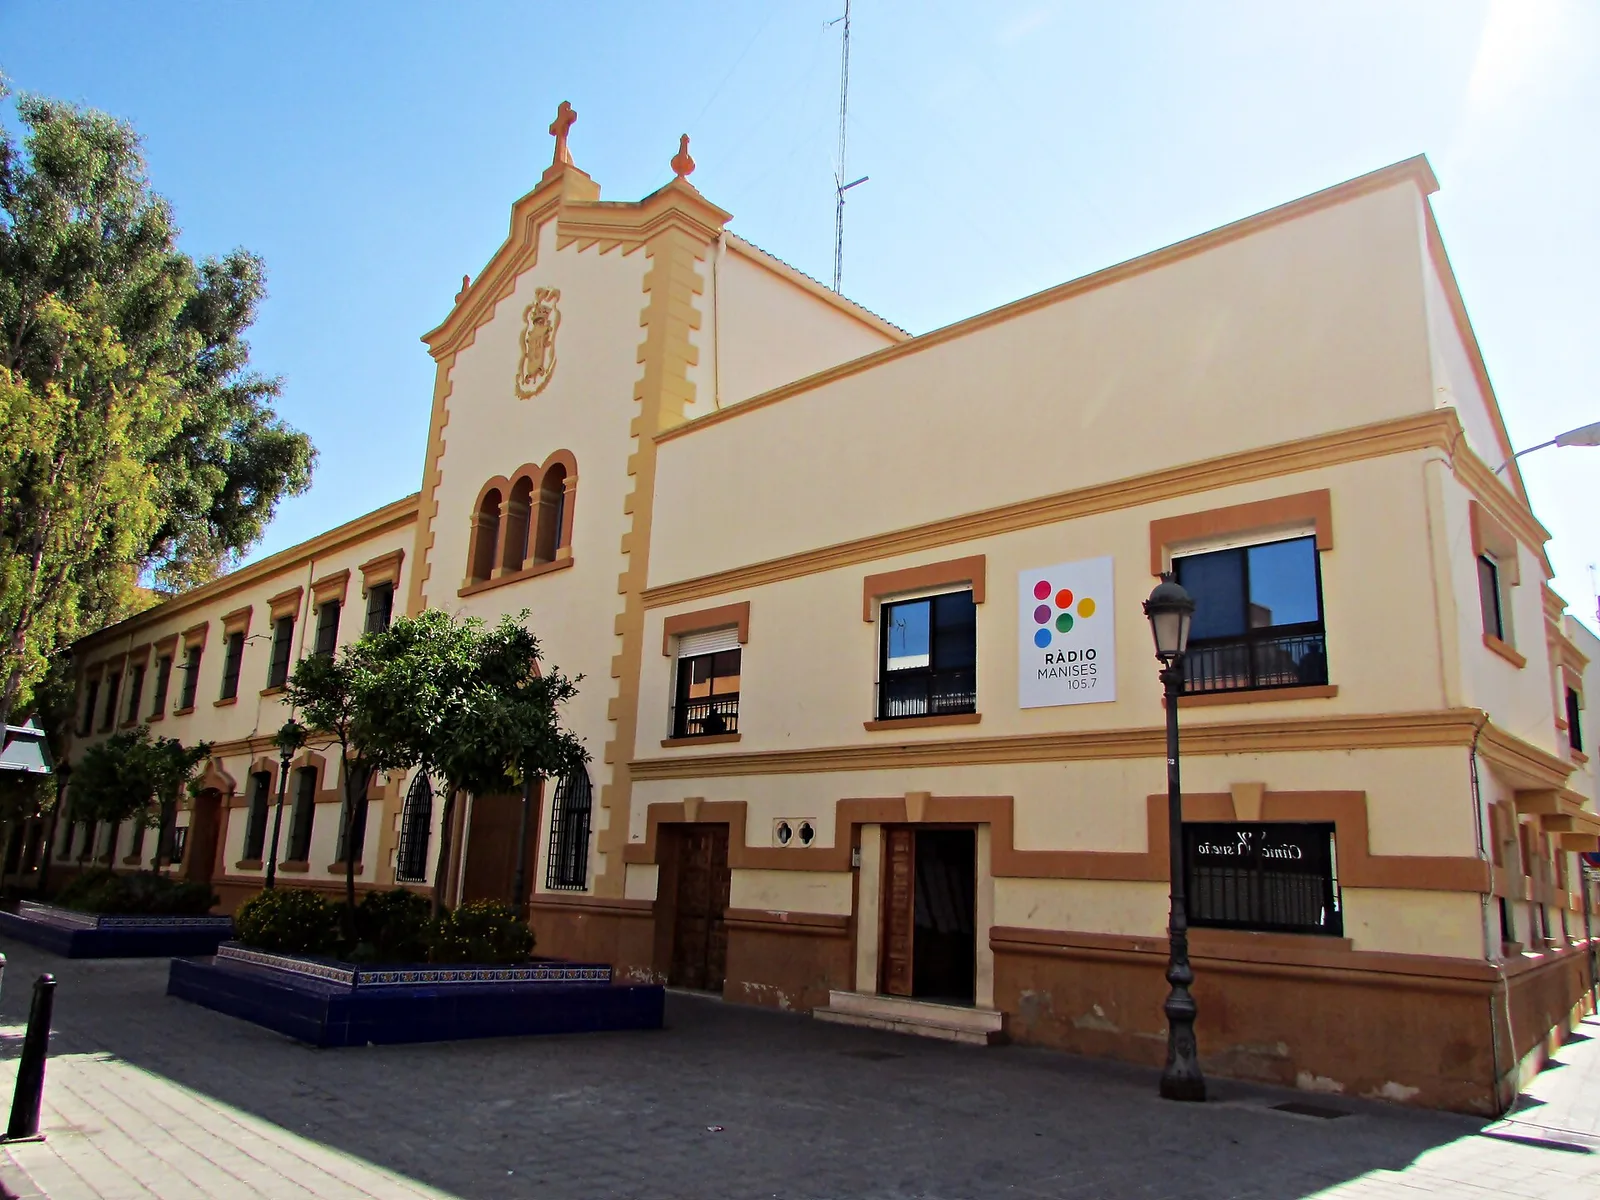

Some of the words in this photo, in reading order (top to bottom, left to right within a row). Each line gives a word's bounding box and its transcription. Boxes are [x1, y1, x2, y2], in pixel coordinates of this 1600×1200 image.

[1045, 649, 1097, 665] RÀDIO
[1037, 663, 1097, 680] MANISES
[1068, 678, 1097, 690] 105.7
